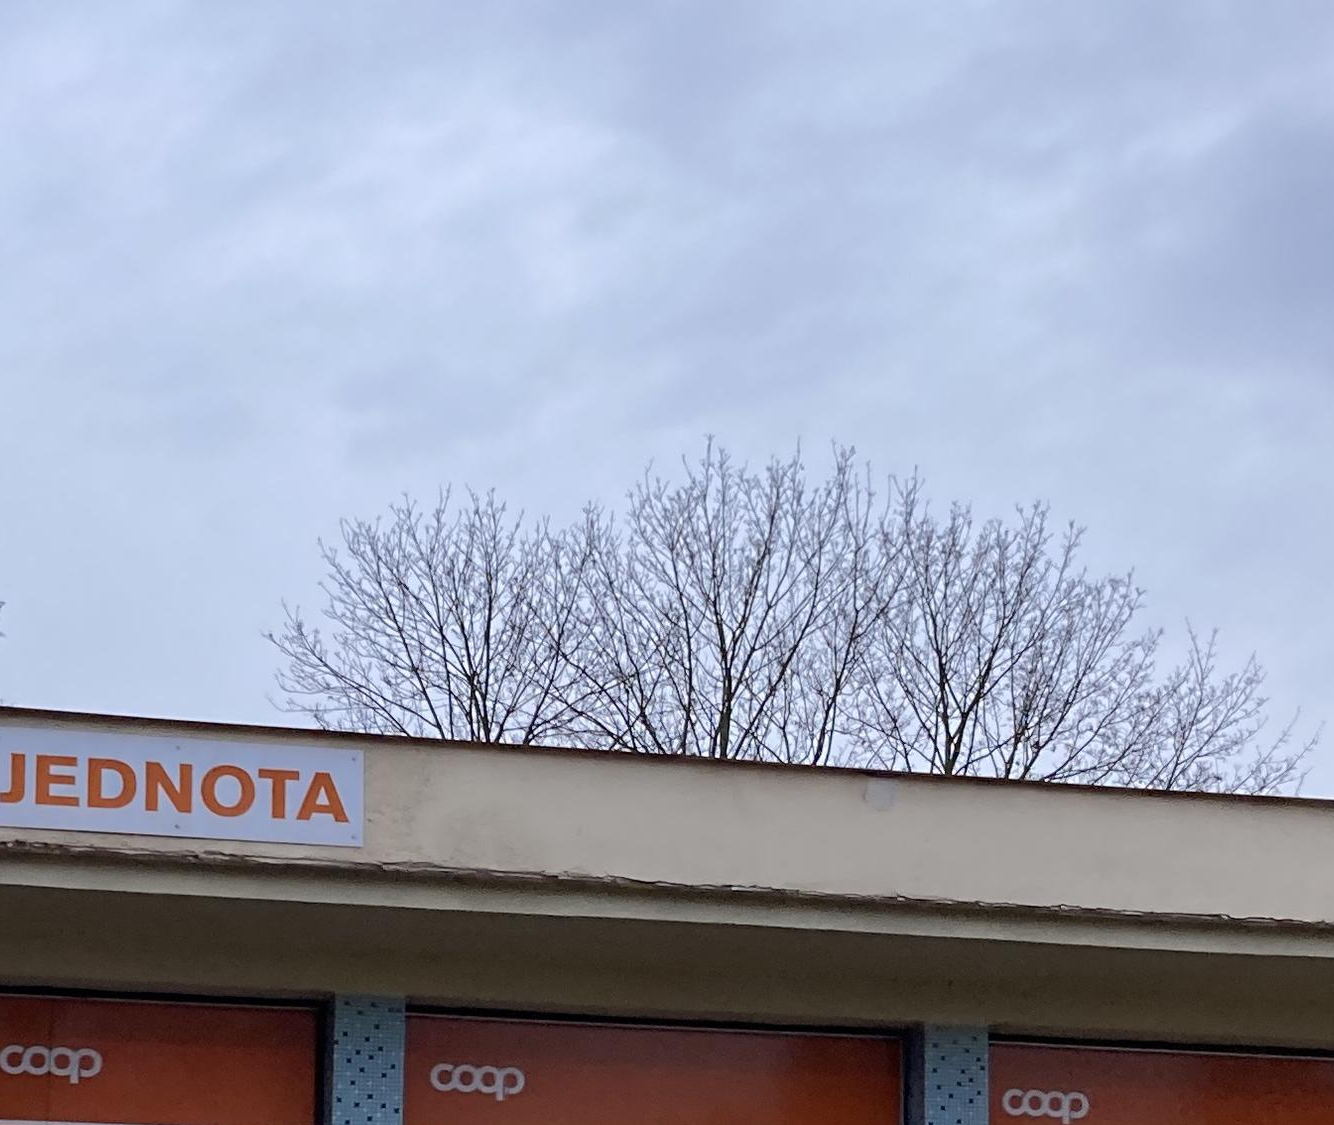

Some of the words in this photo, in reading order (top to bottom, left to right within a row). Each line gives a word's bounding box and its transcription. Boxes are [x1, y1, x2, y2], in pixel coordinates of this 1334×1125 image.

[0, 752, 349, 824] JEDNOTA
[430, 1063, 525, 1101] coop
[1002, 1088, 1089, 1125] coop
